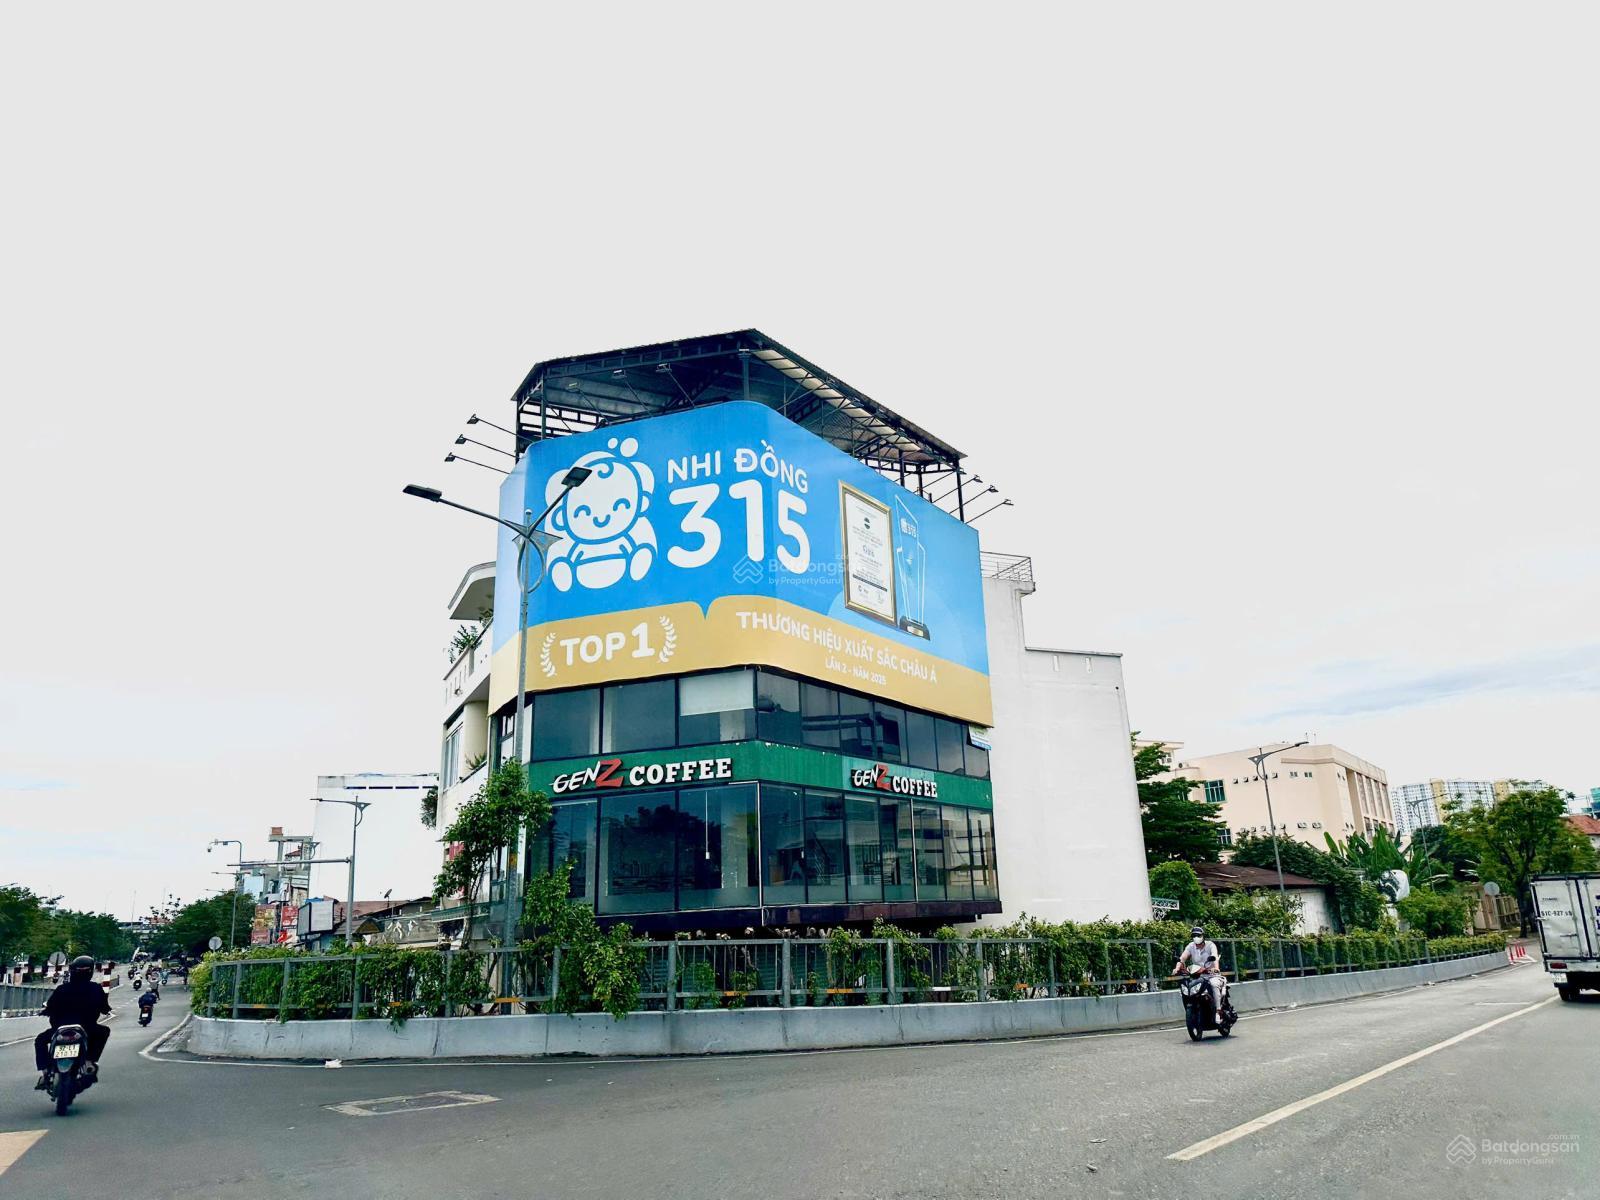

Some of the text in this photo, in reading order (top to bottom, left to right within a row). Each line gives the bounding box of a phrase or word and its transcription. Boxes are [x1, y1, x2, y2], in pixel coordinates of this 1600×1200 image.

[667, 439, 809, 494] NHI ĐỒNG
[667, 479, 811, 574] 315
[559, 622, 656, 666] TOP 1
[735, 611, 810, 641] THƯƠNG
[813, 627, 842, 653] HIỆU
[845, 636, 874, 663] XUẤT
[876, 647, 898, 671] SẮC
[629, 757, 732, 786] COFFEE
[892, 776, 938, 798] COFFEE
